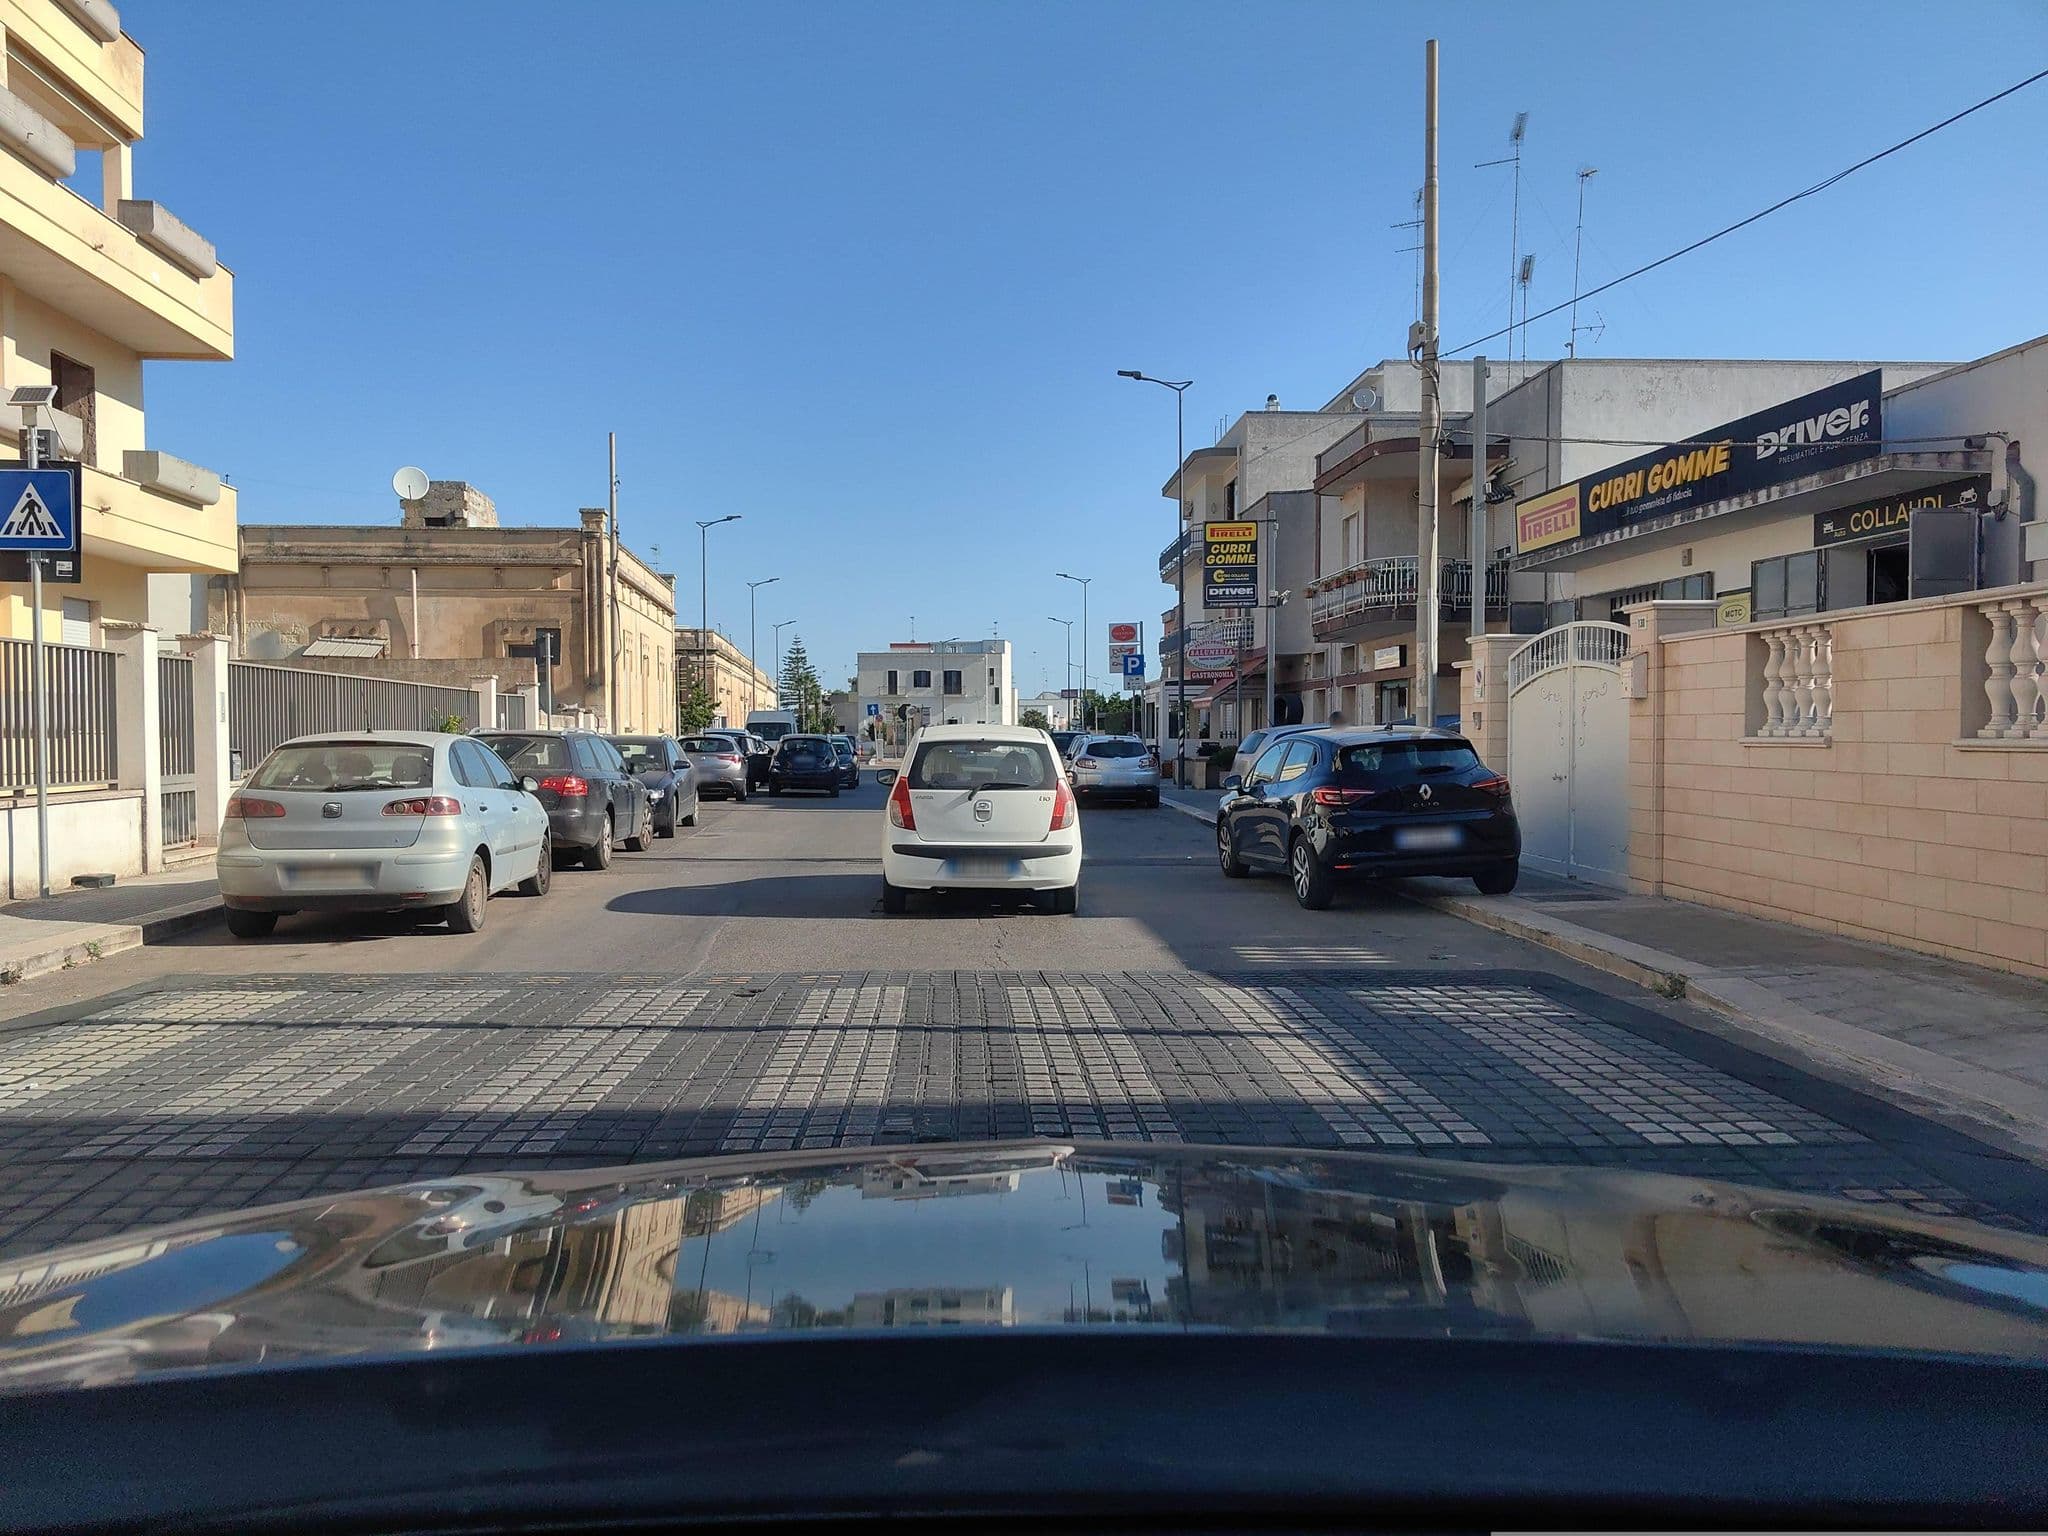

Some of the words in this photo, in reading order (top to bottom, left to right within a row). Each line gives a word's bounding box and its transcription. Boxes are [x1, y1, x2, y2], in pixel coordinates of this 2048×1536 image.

[1588, 470, 1645, 512] CURRI
[1647, 439, 1732, 494] GOMME
[1519, 496, 1578, 543] PIRELLI
[1210, 527, 1253, 538] PIRELLI
[1210, 543, 1252, 554] CURRI
[1206, 554, 1256, 565] GOMME
[1127, 656, 1141, 674] P
[1192, 671, 1235, 680] GASTRONOMIA
